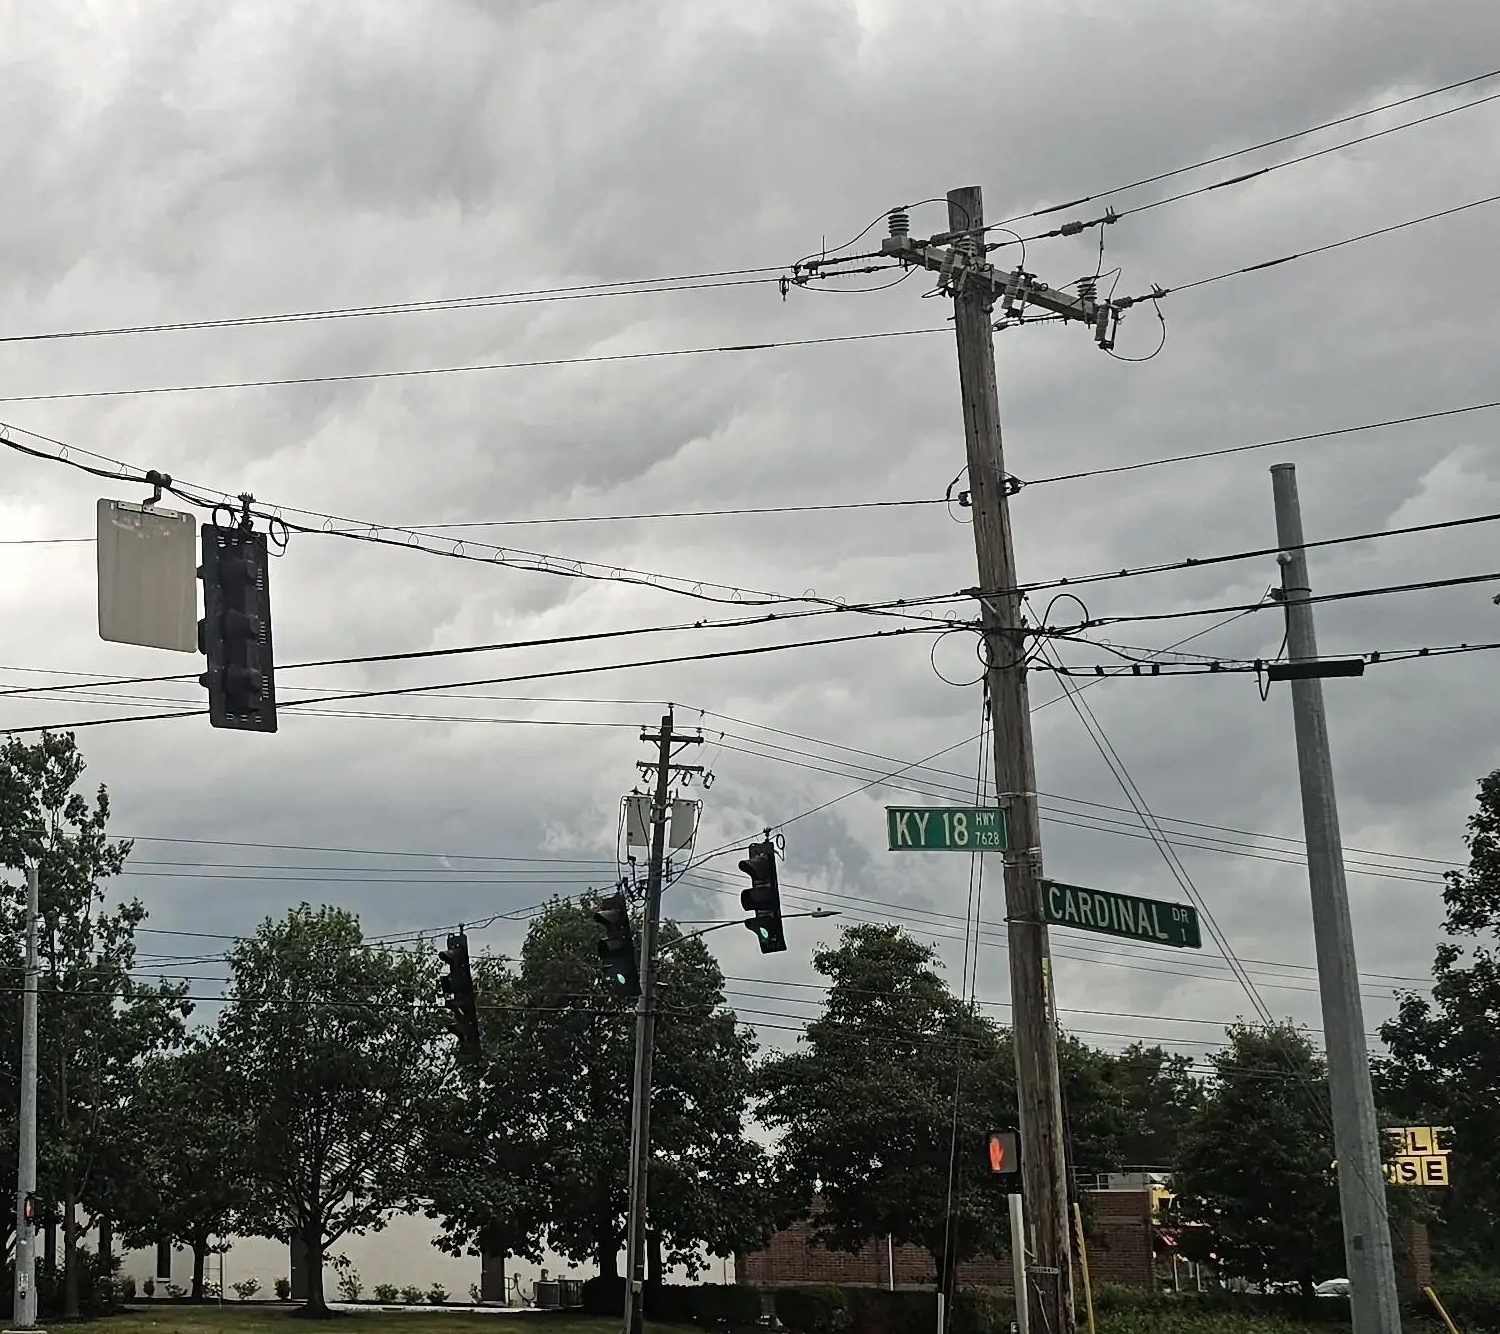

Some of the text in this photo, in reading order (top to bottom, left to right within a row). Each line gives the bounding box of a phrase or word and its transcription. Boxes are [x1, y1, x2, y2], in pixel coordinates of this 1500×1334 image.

[895, 812, 996, 846] KY 18 HWY
[975, 831, 1000, 845] 7628
[1049, 886, 1190, 940] CARDINAL DR
